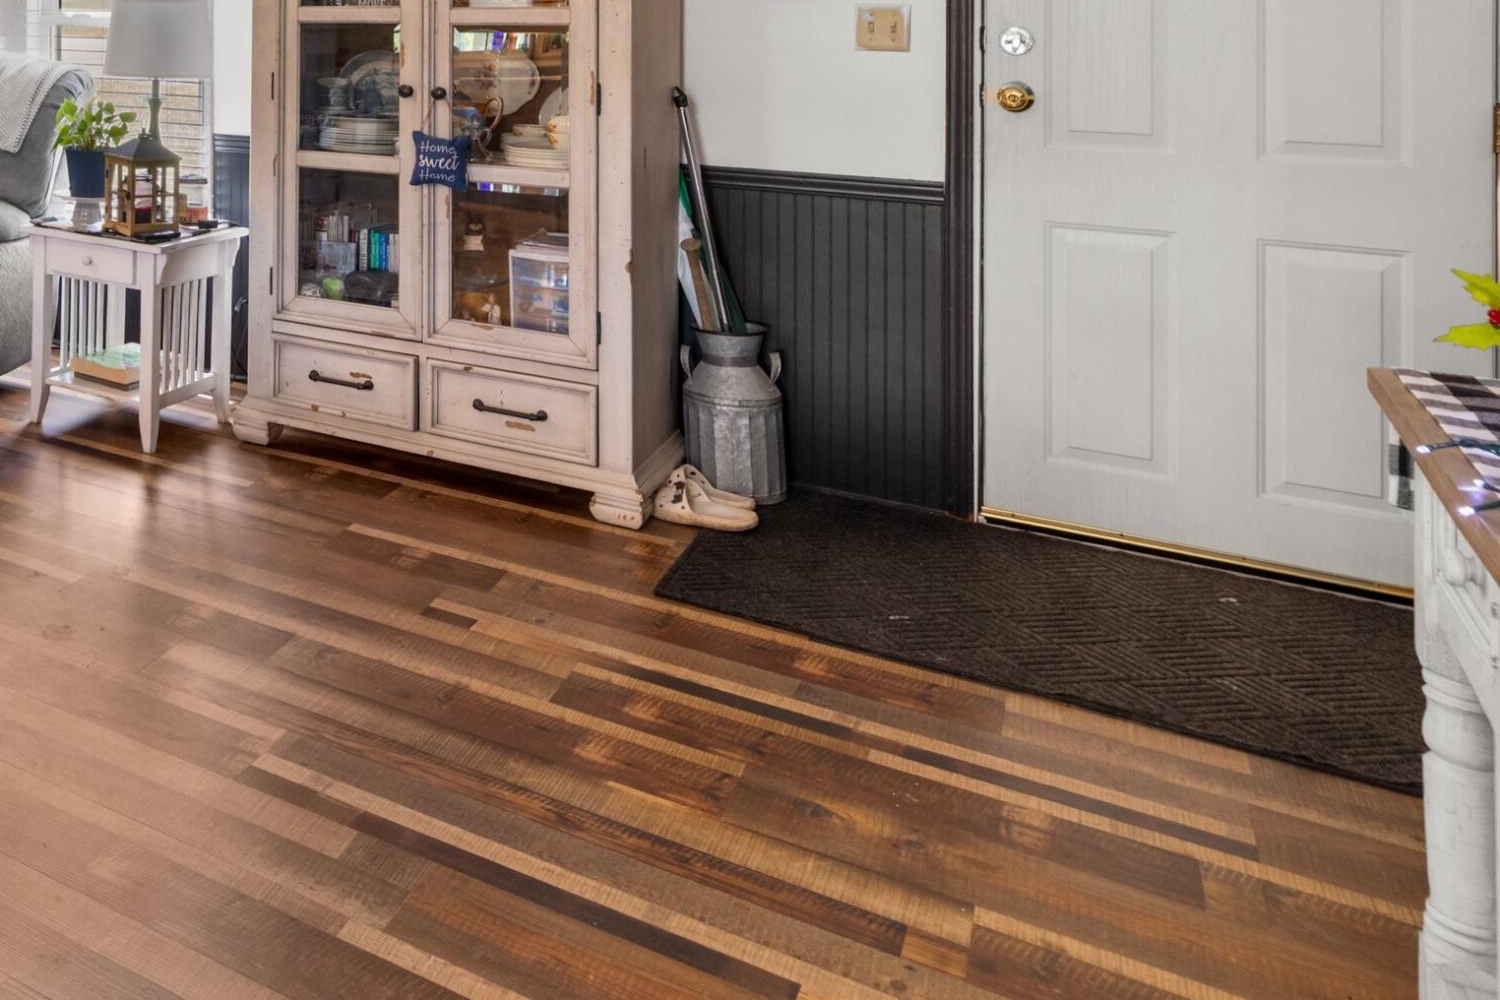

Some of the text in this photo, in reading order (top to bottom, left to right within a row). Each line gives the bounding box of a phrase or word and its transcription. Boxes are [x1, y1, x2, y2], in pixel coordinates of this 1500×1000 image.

[419, 139, 455, 154] Home
[418, 151, 460, 171] sweet
[419, 167, 456, 183] Home
